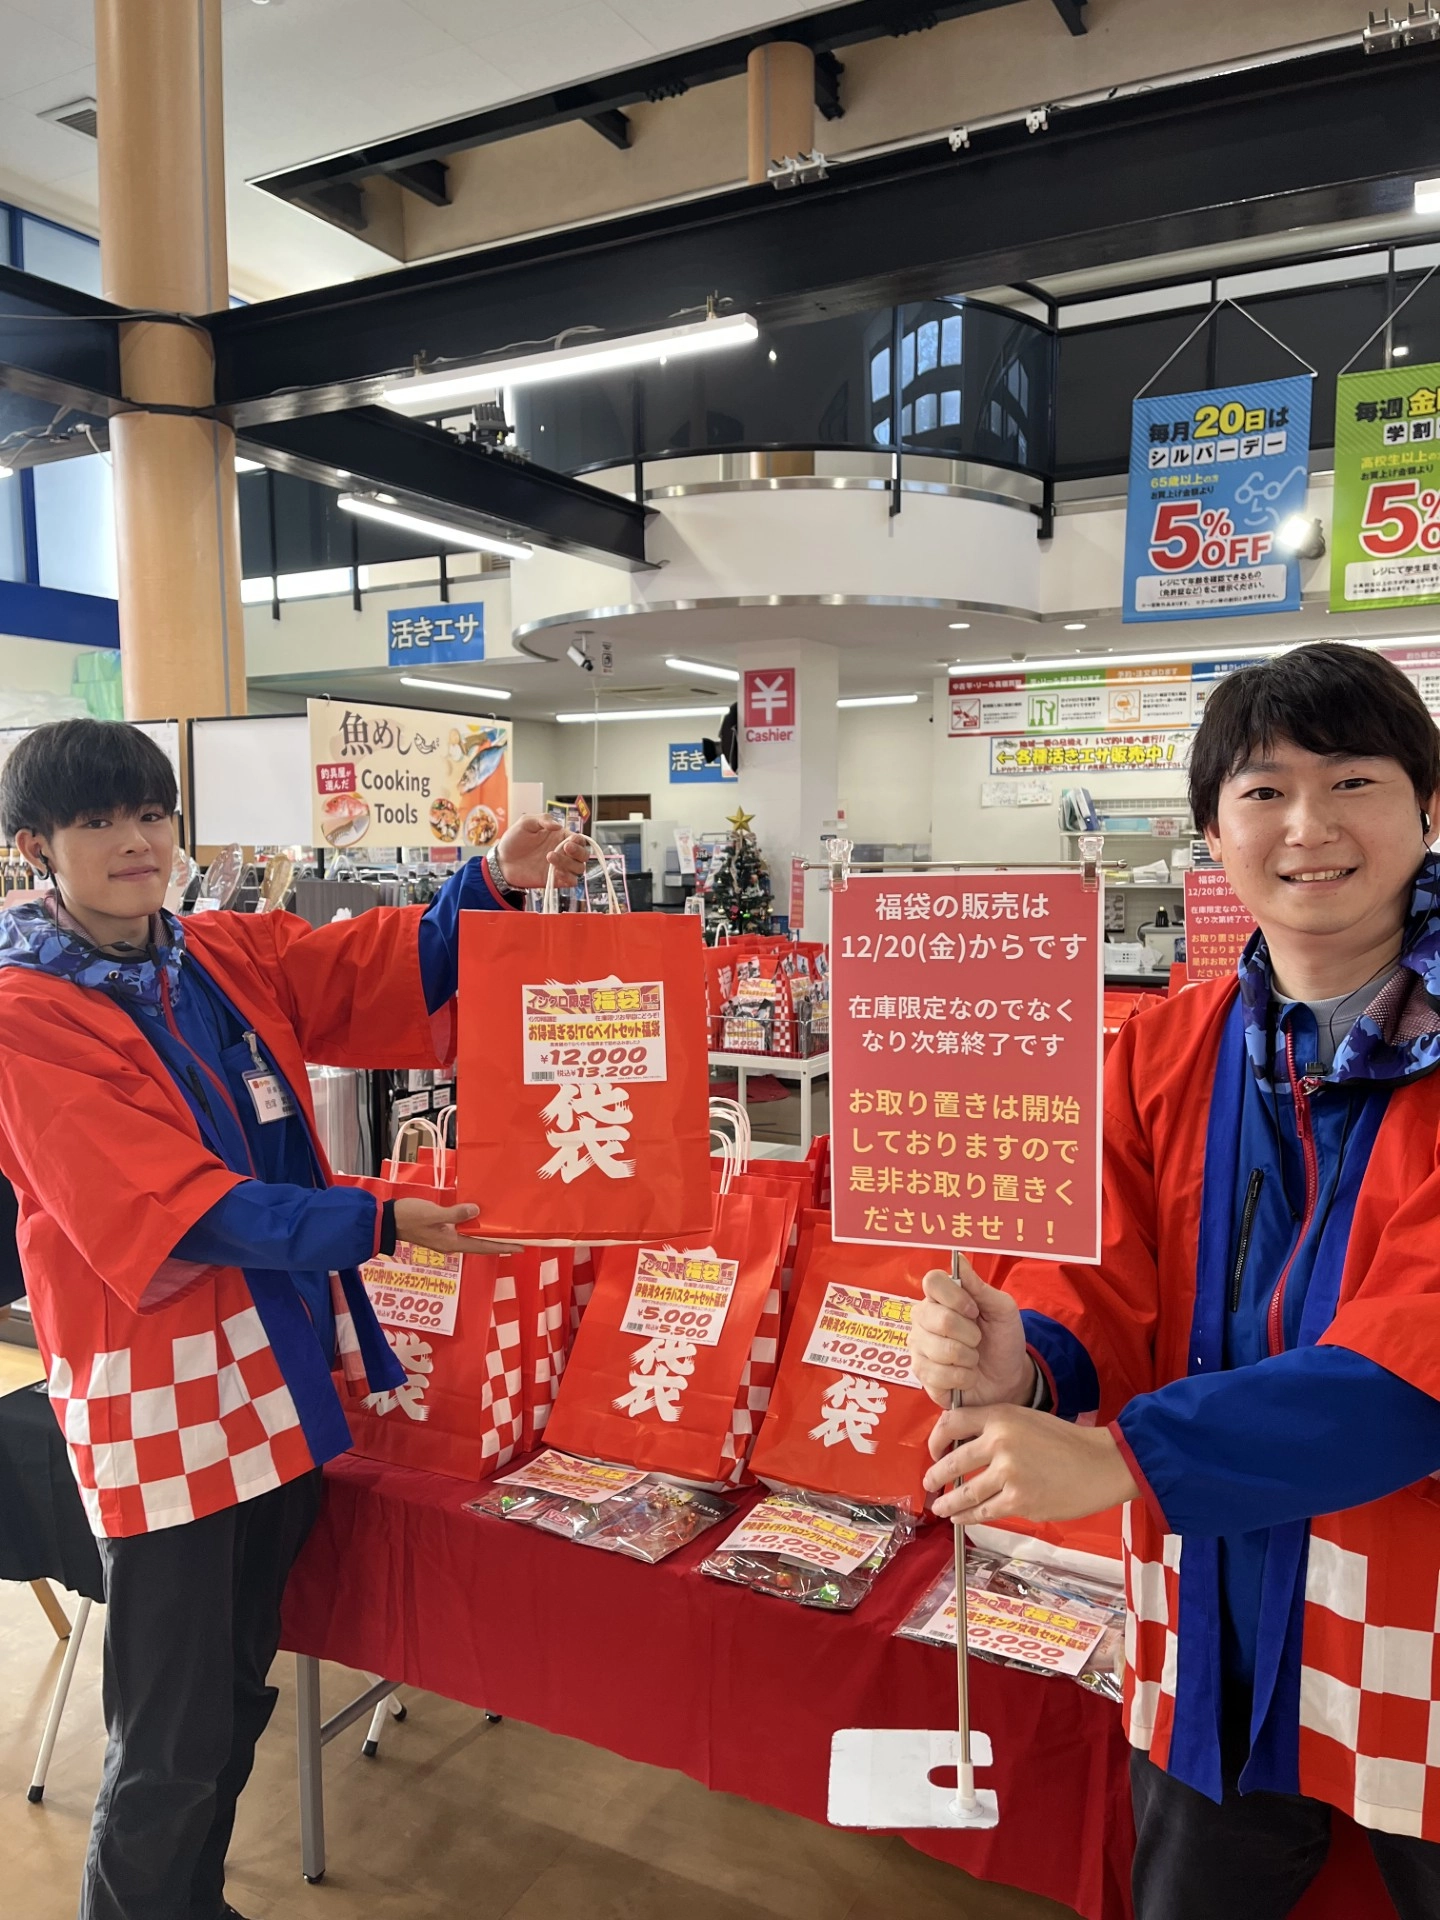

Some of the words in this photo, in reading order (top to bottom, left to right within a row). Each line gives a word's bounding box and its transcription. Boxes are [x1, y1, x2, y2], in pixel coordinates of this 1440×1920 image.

[1355, 387, 1440, 422] 毎週金
[1150, 401, 1289, 443] 毎月20日は
[1386, 421, 1440, 442] 学割
[1152, 438, 1282, 466] シルバーデー
[1200, 533, 1272, 567] OFF
[390, 613, 480, 648] 活きエサ
[339, 710, 413, 757] 魚めし
[746, 728, 794, 743] Cashier
[321, 766, 351, 779] 釣具屋が
[325, 779, 349, 791] 選んだ
[361, 768, 431, 798] Cooking
[374, 802, 418, 824] Tools
[1198, 875, 1228, 885] 福袋の
[875, 892, 1050, 921] 福袋の販売は
[840, 932, 1088, 963] 12/20(金)からです
[848, 994, 1074, 1023] 在庫限定なのでなく
[862, 1029, 1065, 1058] なり次第終了です
[849, 1088, 1081, 1125] お取り置きは開始
[851, 1128, 1079, 1165] しておりますので
[849, 1166, 1075, 1206] 是非お取り置きく
[943, 1607, 1090, 1651] 伊湾ジギング攻略セット福袋
